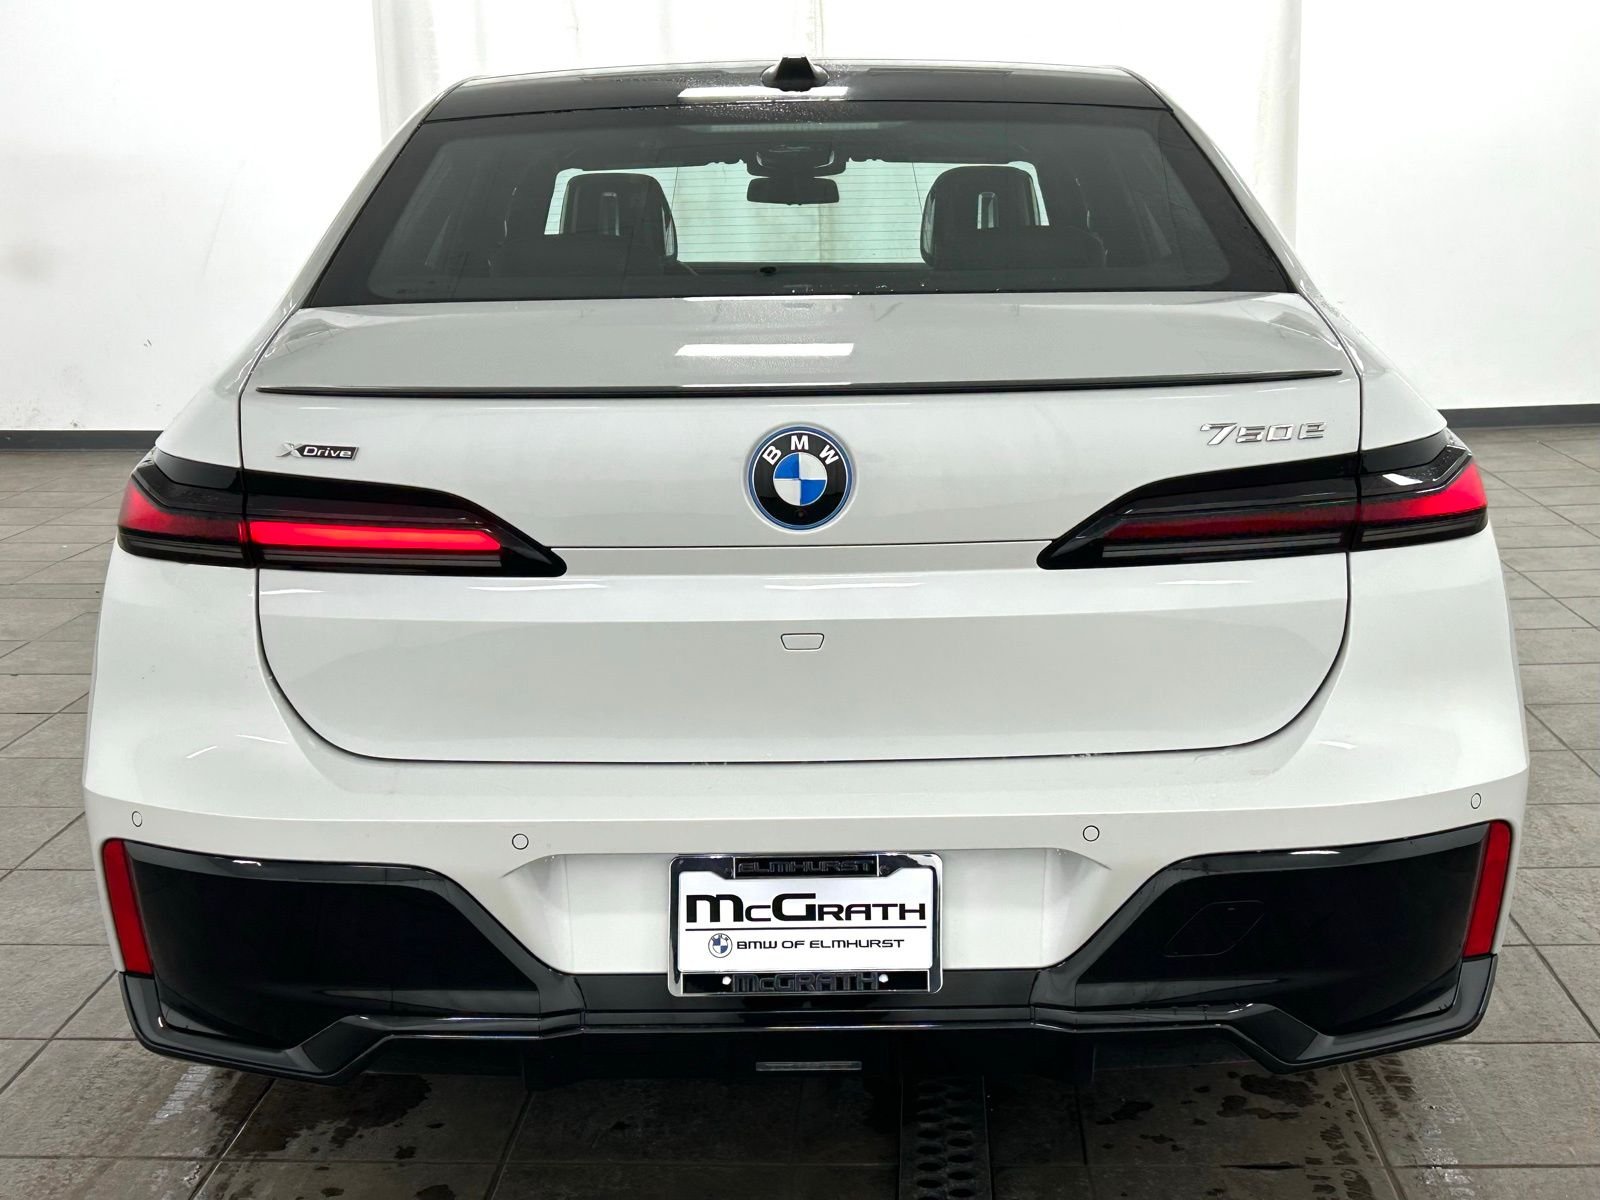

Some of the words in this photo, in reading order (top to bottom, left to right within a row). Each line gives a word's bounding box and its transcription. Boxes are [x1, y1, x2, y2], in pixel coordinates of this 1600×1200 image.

[762, 435, 839, 466] BMW
[737, 860, 873, 873] ELMHURST
[736, 940, 778, 950] BMW
[781, 940, 805, 949] OF
[809, 939, 905, 949] ELMHURST
